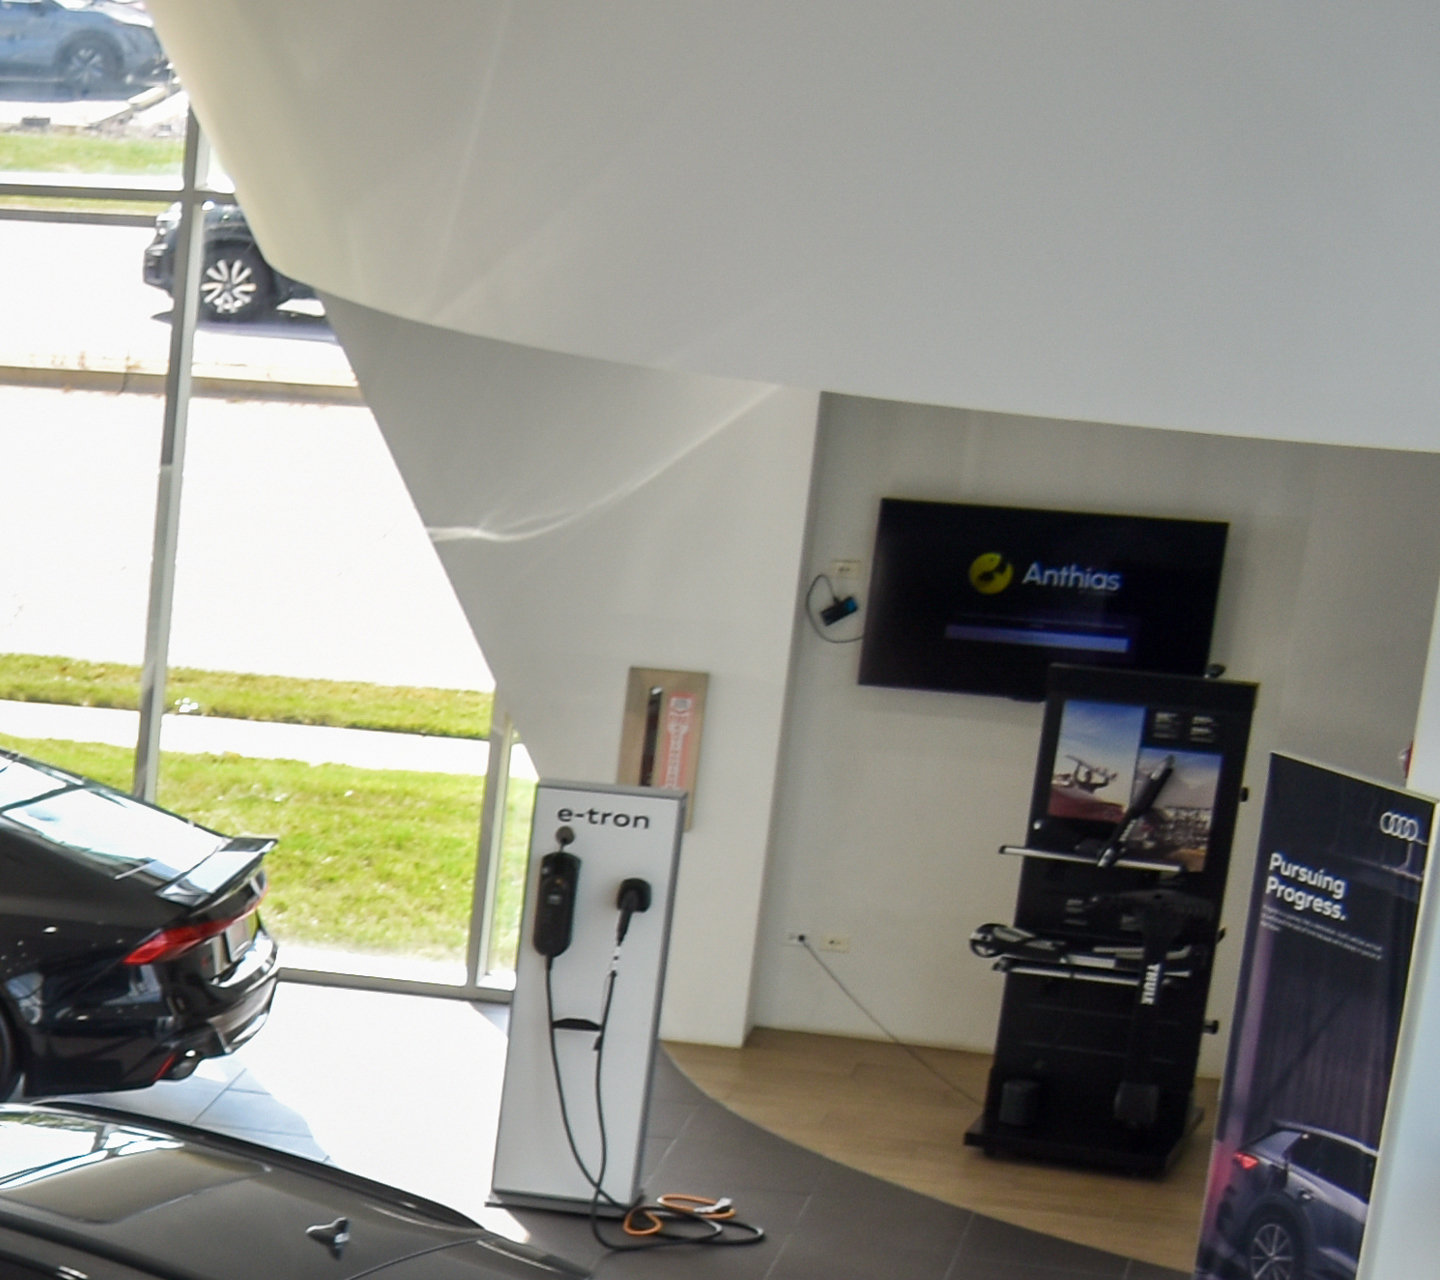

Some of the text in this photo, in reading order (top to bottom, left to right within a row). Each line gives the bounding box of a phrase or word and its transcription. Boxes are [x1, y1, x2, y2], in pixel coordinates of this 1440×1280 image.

[1022, 561, 1121, 592] Anthias
[557, 806, 650, 829] e-tron
[1268, 852, 1346, 900] Pursuing
[1265, 876, 1347, 921] Progress.
